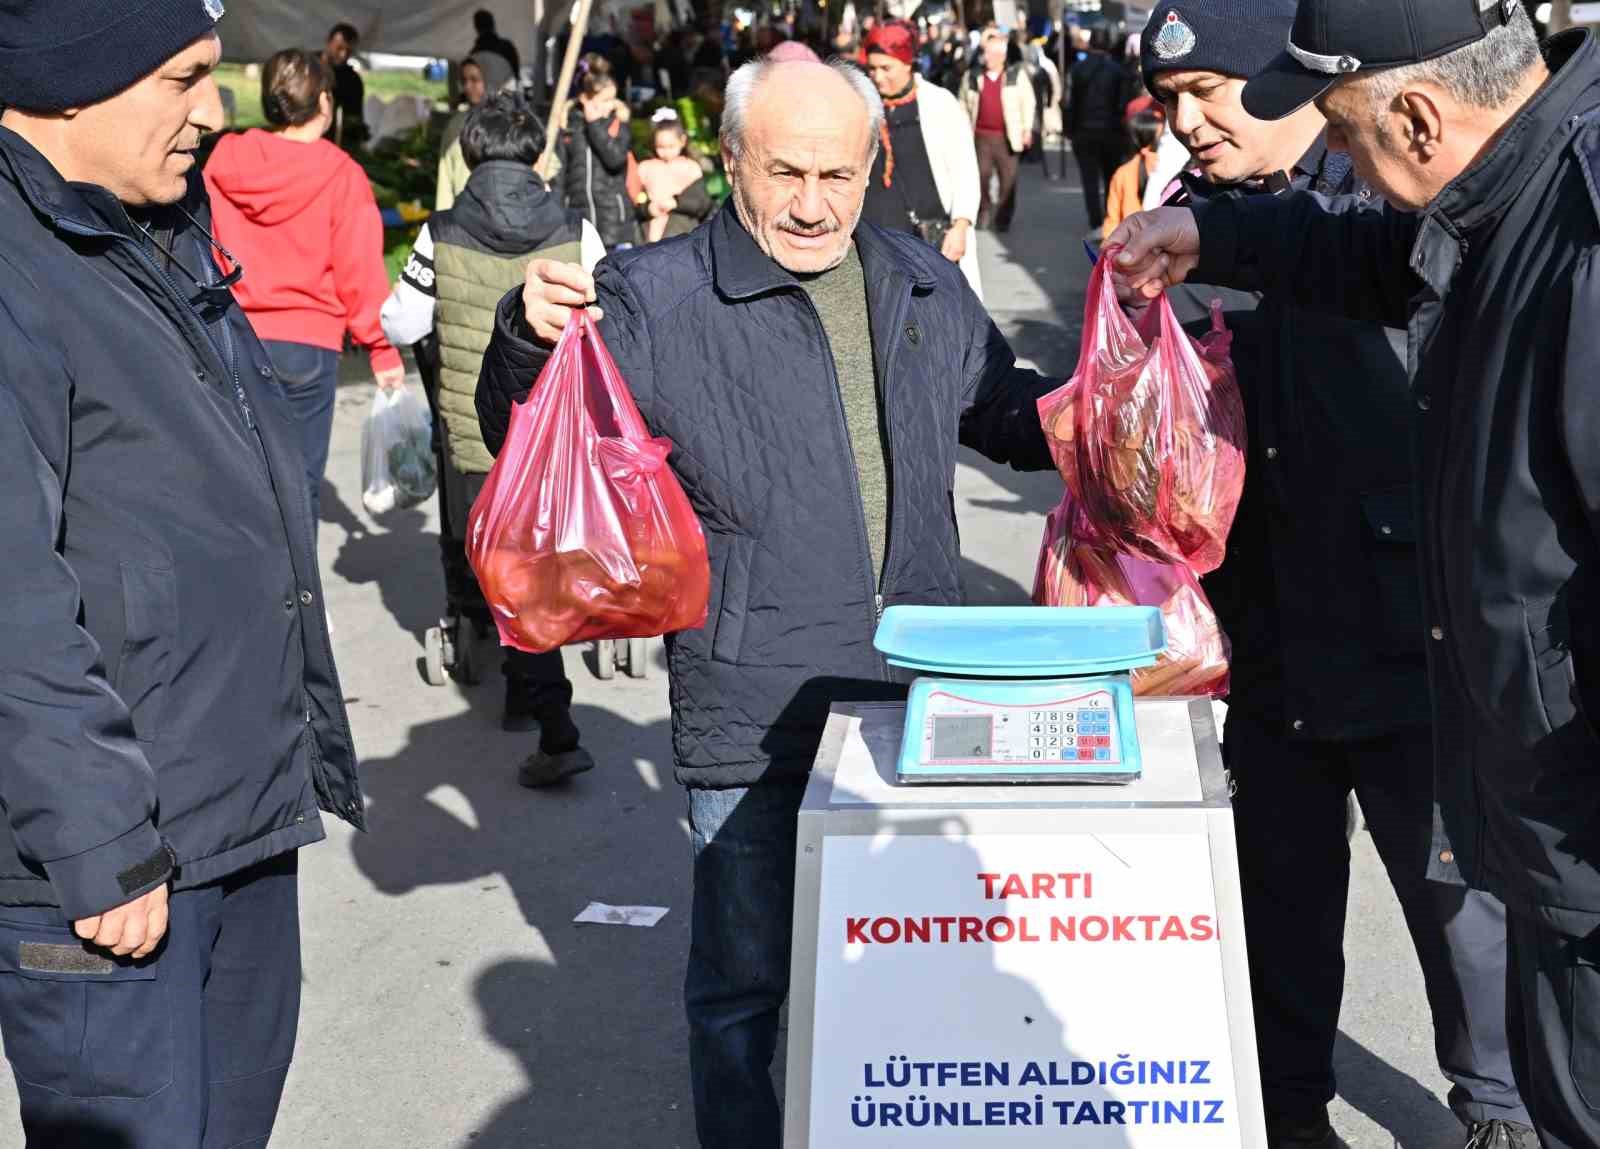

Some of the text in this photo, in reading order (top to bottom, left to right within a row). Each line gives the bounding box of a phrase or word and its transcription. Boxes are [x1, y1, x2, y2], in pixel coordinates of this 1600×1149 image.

[1034, 712, 1041, 720] 7
[1050, 712, 1057, 721] 8
[1066, 712, 1074, 721] 9
[1033, 725, 1040, 733] 4
[1050, 724, 1057, 733] 5
[1066, 725, 1074, 733] 6
[1034, 737, 1040, 746] 1
[1050, 737, 1057, 746] 2
[1066, 737, 1074, 746] 3
[1033, 750, 1041, 758] 0
[978, 872, 1092, 899] TARTI
[847, 915, 1040, 944] KONTROL
[864, 1053, 1211, 1088] LÜTFEN ALDIĞINIZ
[851, 1094, 1225, 1127] ÜRÜNLERİ TARTINIZ
